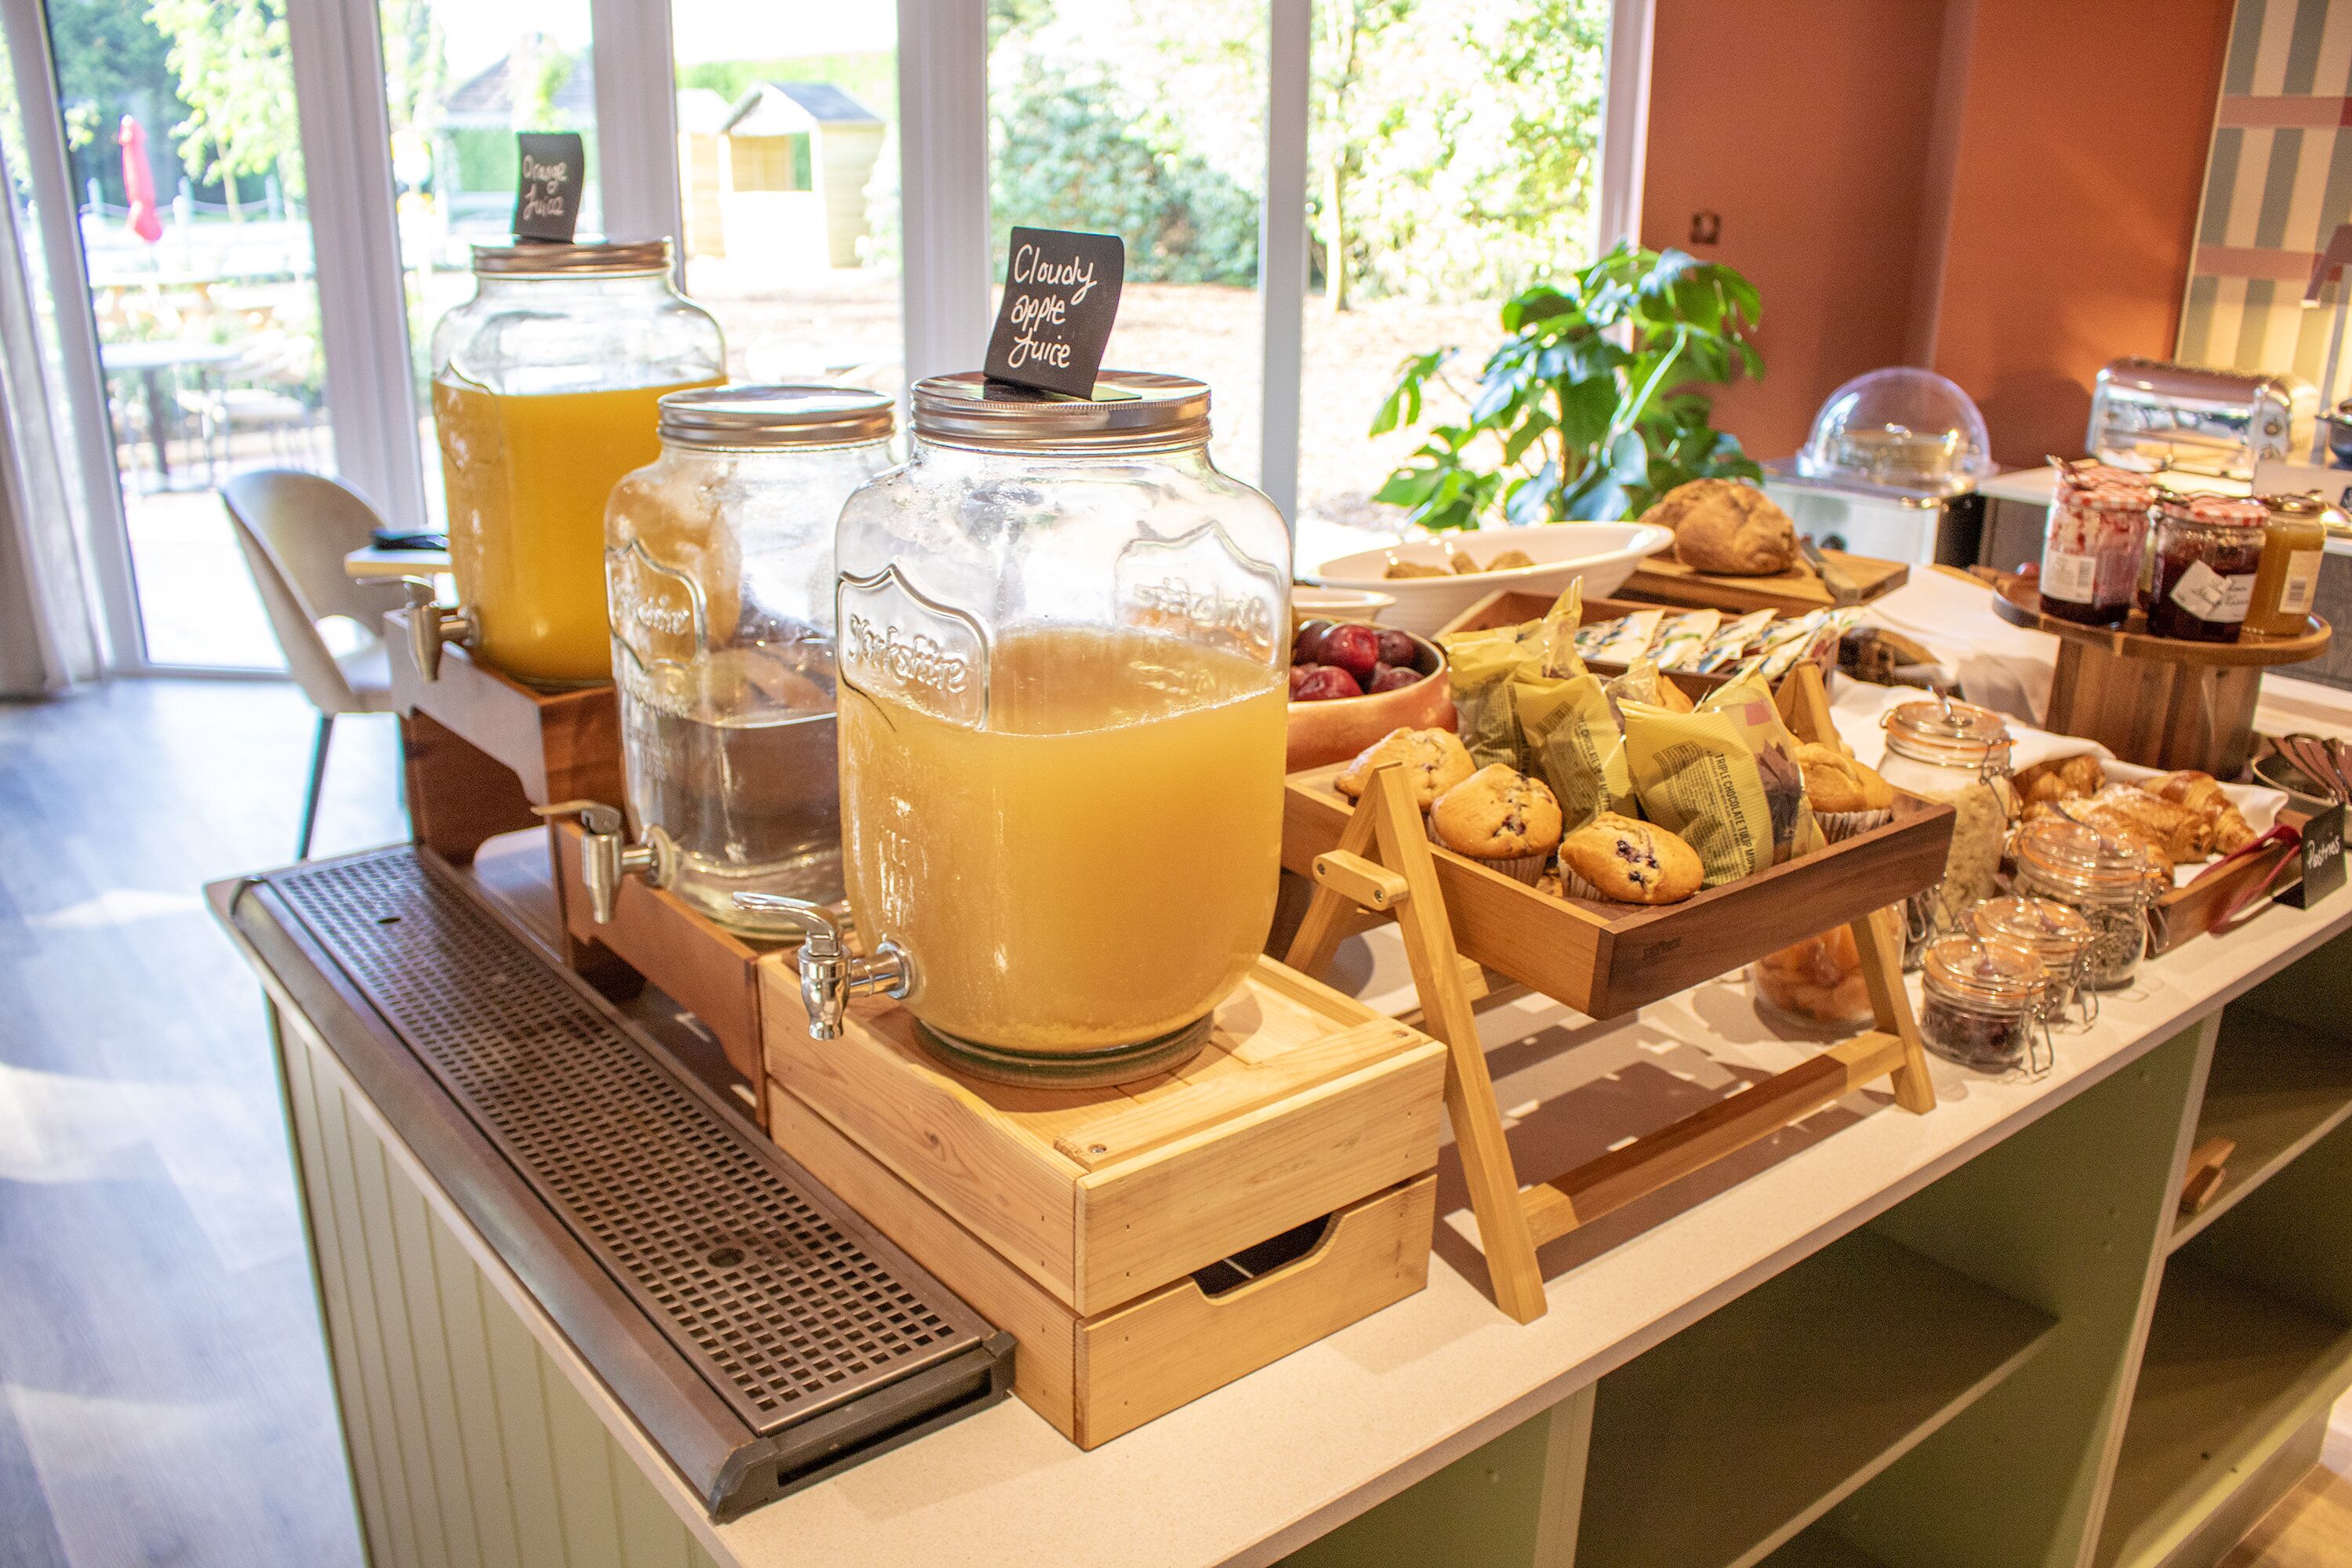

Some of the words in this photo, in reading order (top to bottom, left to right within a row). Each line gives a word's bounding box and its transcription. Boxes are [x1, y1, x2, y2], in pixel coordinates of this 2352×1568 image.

[1014, 244, 1097, 305] Cloudy
[1011, 294, 1065, 332] apple
[1715, 753, 1728, 780] TRIPLE
[1723, 780, 1746, 826] CHOCOLATE
[1737, 823, 1752, 848] TULIP
